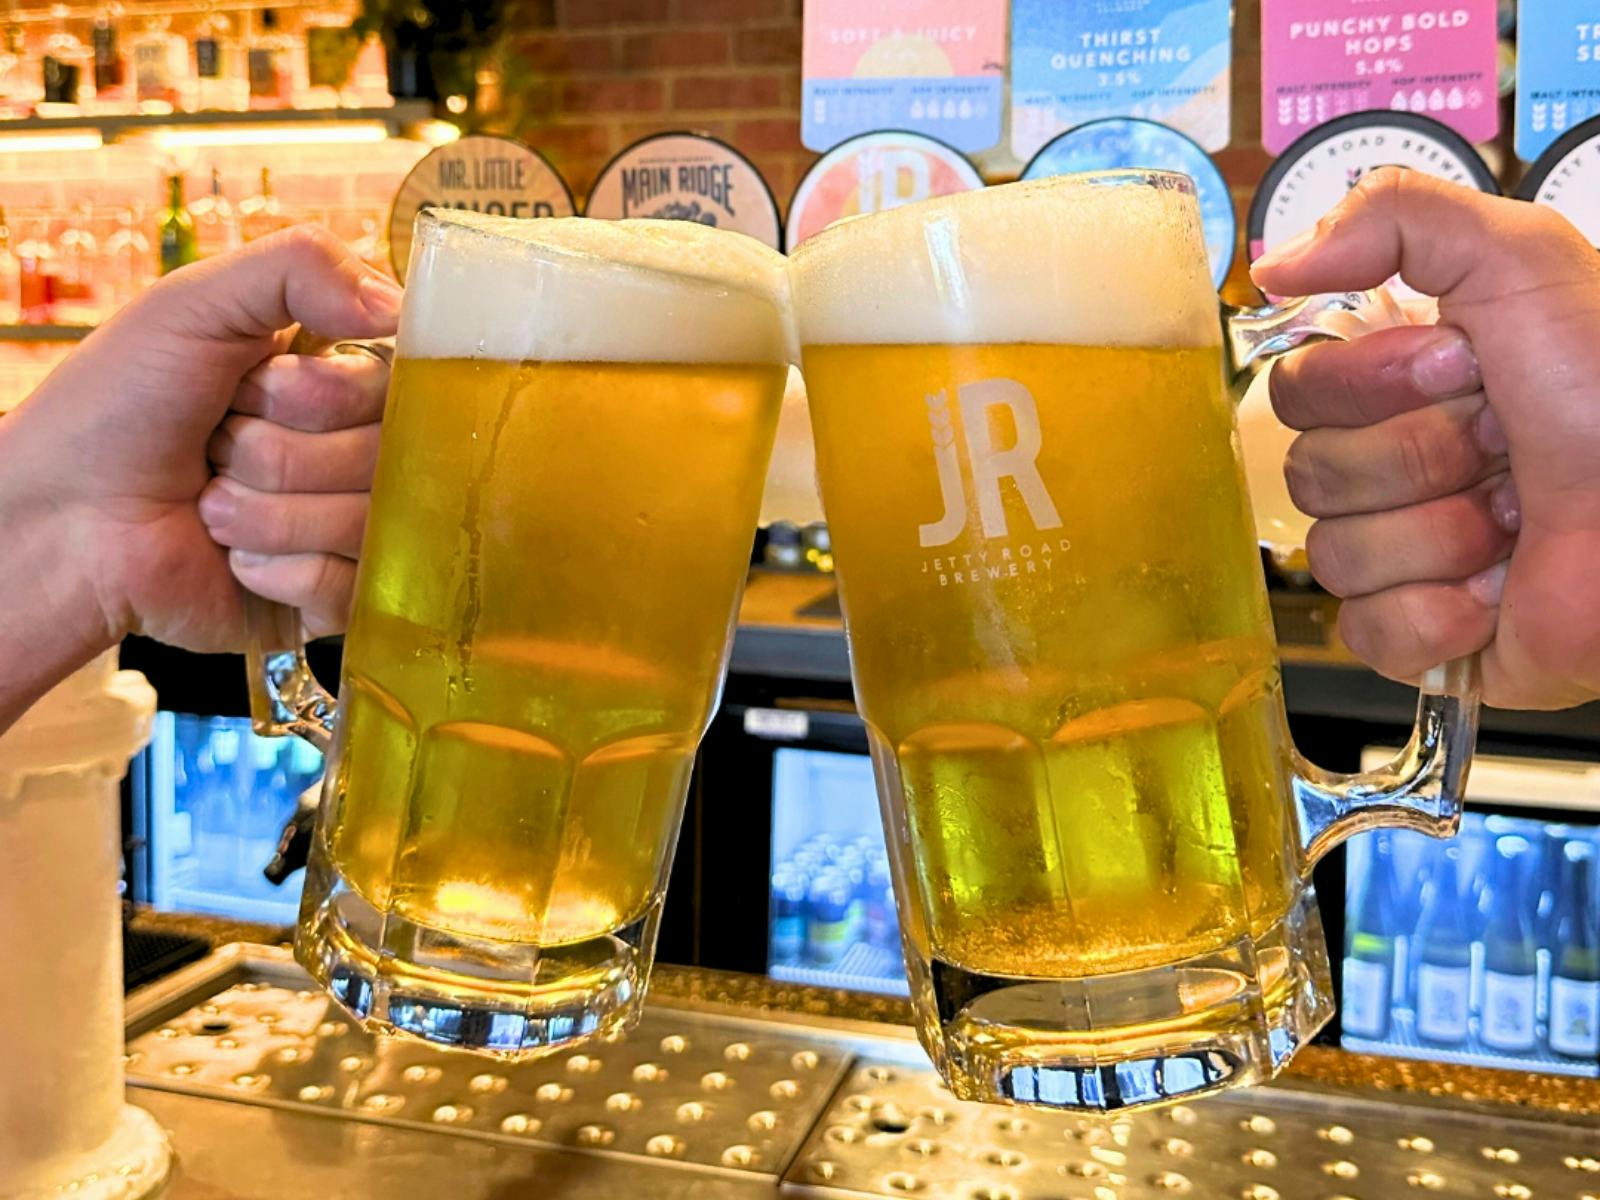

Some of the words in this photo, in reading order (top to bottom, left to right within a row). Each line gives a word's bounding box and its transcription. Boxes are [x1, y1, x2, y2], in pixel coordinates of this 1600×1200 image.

[1080, 28, 1161, 48] THIRST
[1290, 15, 1391, 39] PUNCHY
[1402, 9, 1470, 31] BOLD
[1051, 45, 1191, 69] QUENCHING
[1345, 35, 1413, 55] HOPS
[1328, 136, 1386, 157] ROAD
[474, 157, 526, 191] LITTLE
[622, 164, 671, 218] MAIN
[678, 163, 736, 217] RIDGE
[918, 376, 1064, 548] JR
[921, 551, 989, 573] JETTY
[1002, 538, 1072, 561] ROAD
[938, 557, 1053, 587] BREWERY
